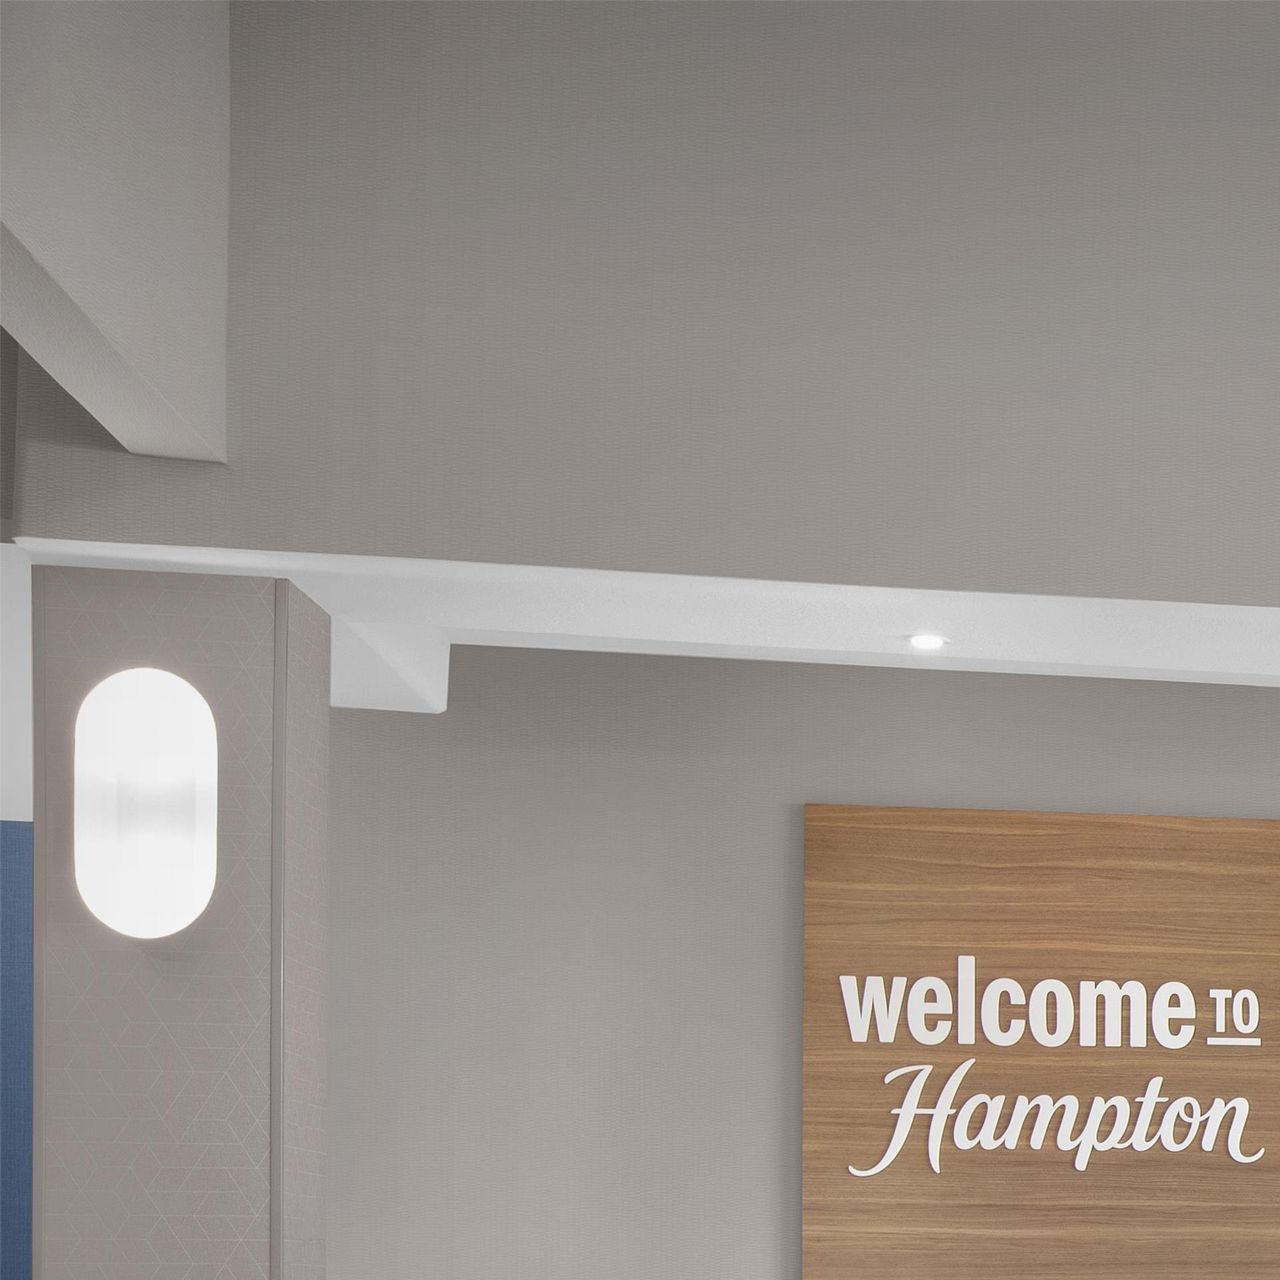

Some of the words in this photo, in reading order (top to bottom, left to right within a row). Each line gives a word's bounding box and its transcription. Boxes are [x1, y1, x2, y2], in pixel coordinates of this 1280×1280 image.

[839, 955, 1197, 1050] welcome
[1208, 988, 1261, 1036] TO
[847, 1057, 1266, 1178] Hampton
